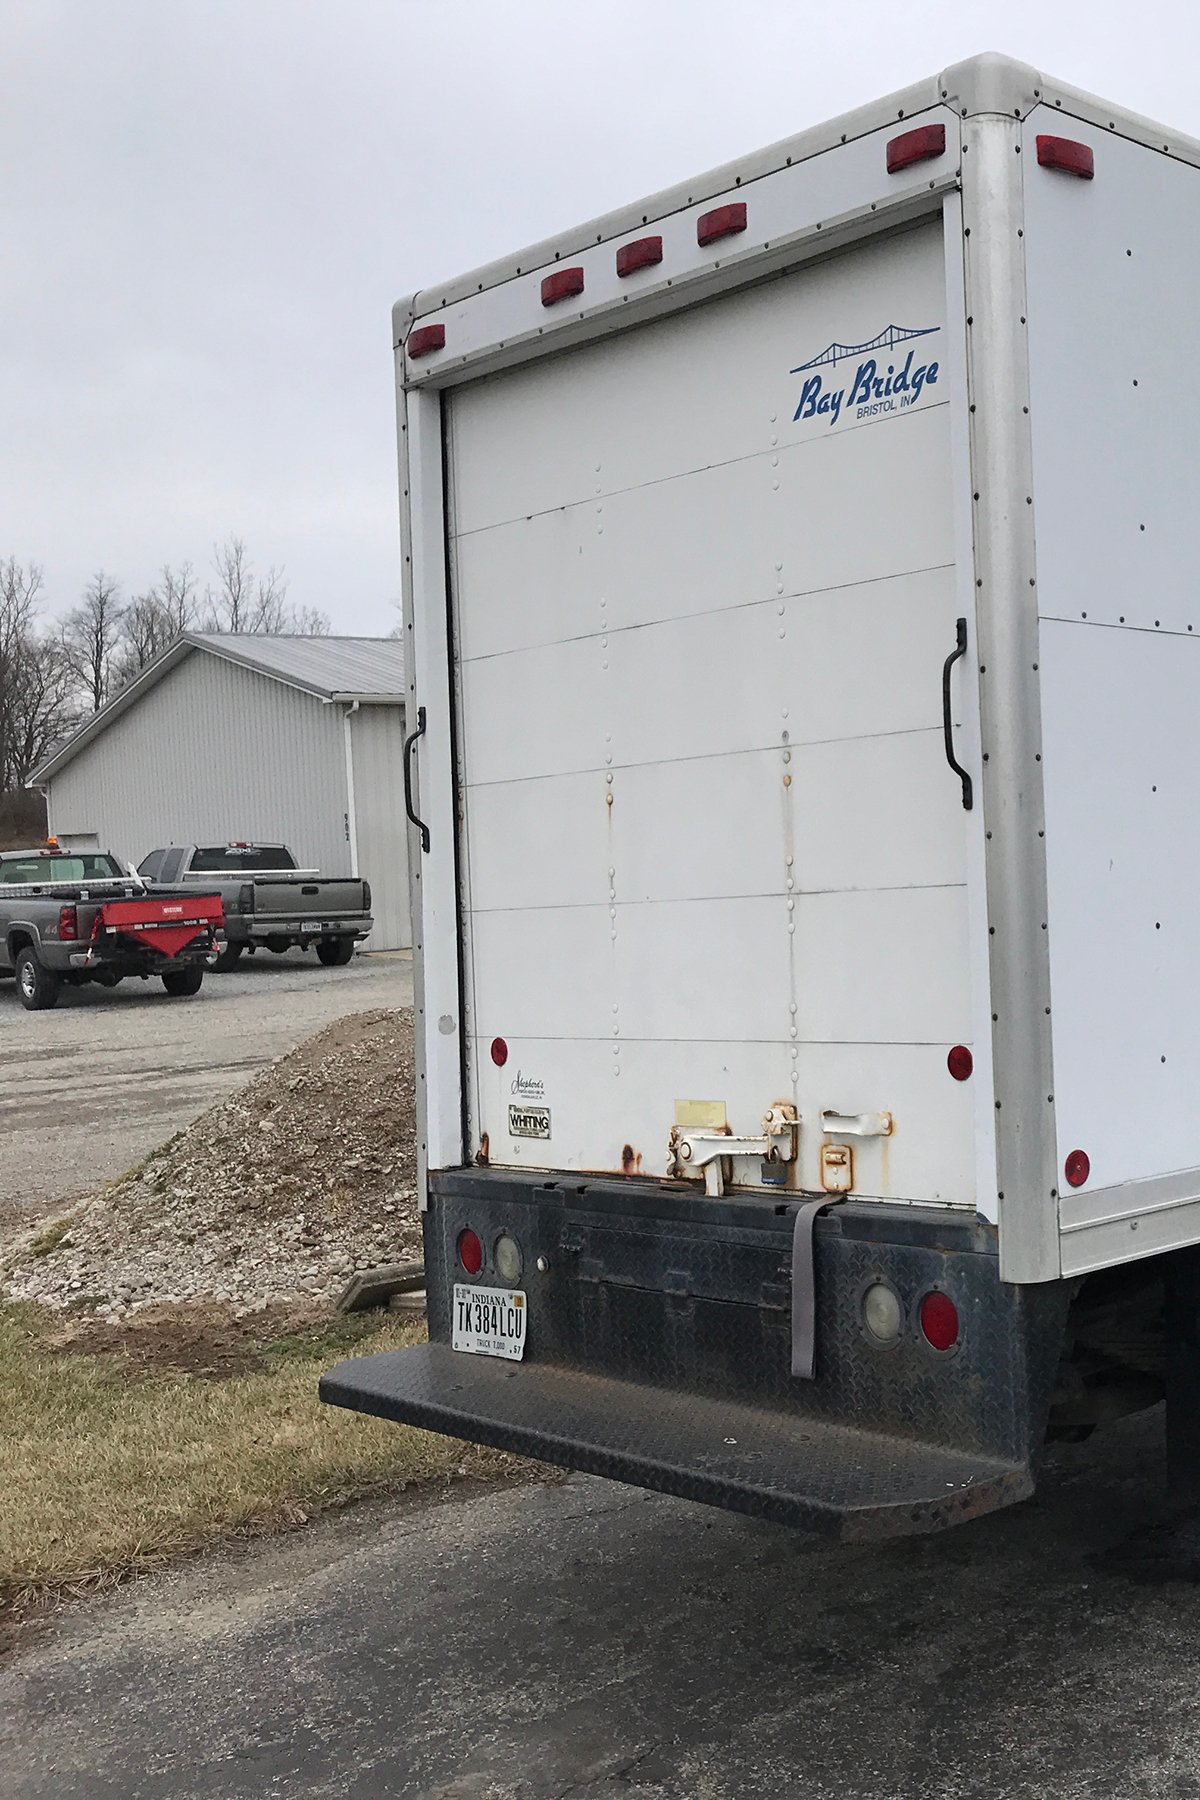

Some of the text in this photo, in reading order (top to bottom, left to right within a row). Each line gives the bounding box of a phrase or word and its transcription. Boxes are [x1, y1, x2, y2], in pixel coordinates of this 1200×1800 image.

[793, 350, 939, 426] Bay Bridge
[856, 394, 911, 419] BRISTOL, IN
[510, 1113, 549, 1130] WHITING
[472, 1294, 507, 1306] INDIANA
[458, 1302, 522, 1339] TK384LCU
[513, 1344, 521, 1355] 57
